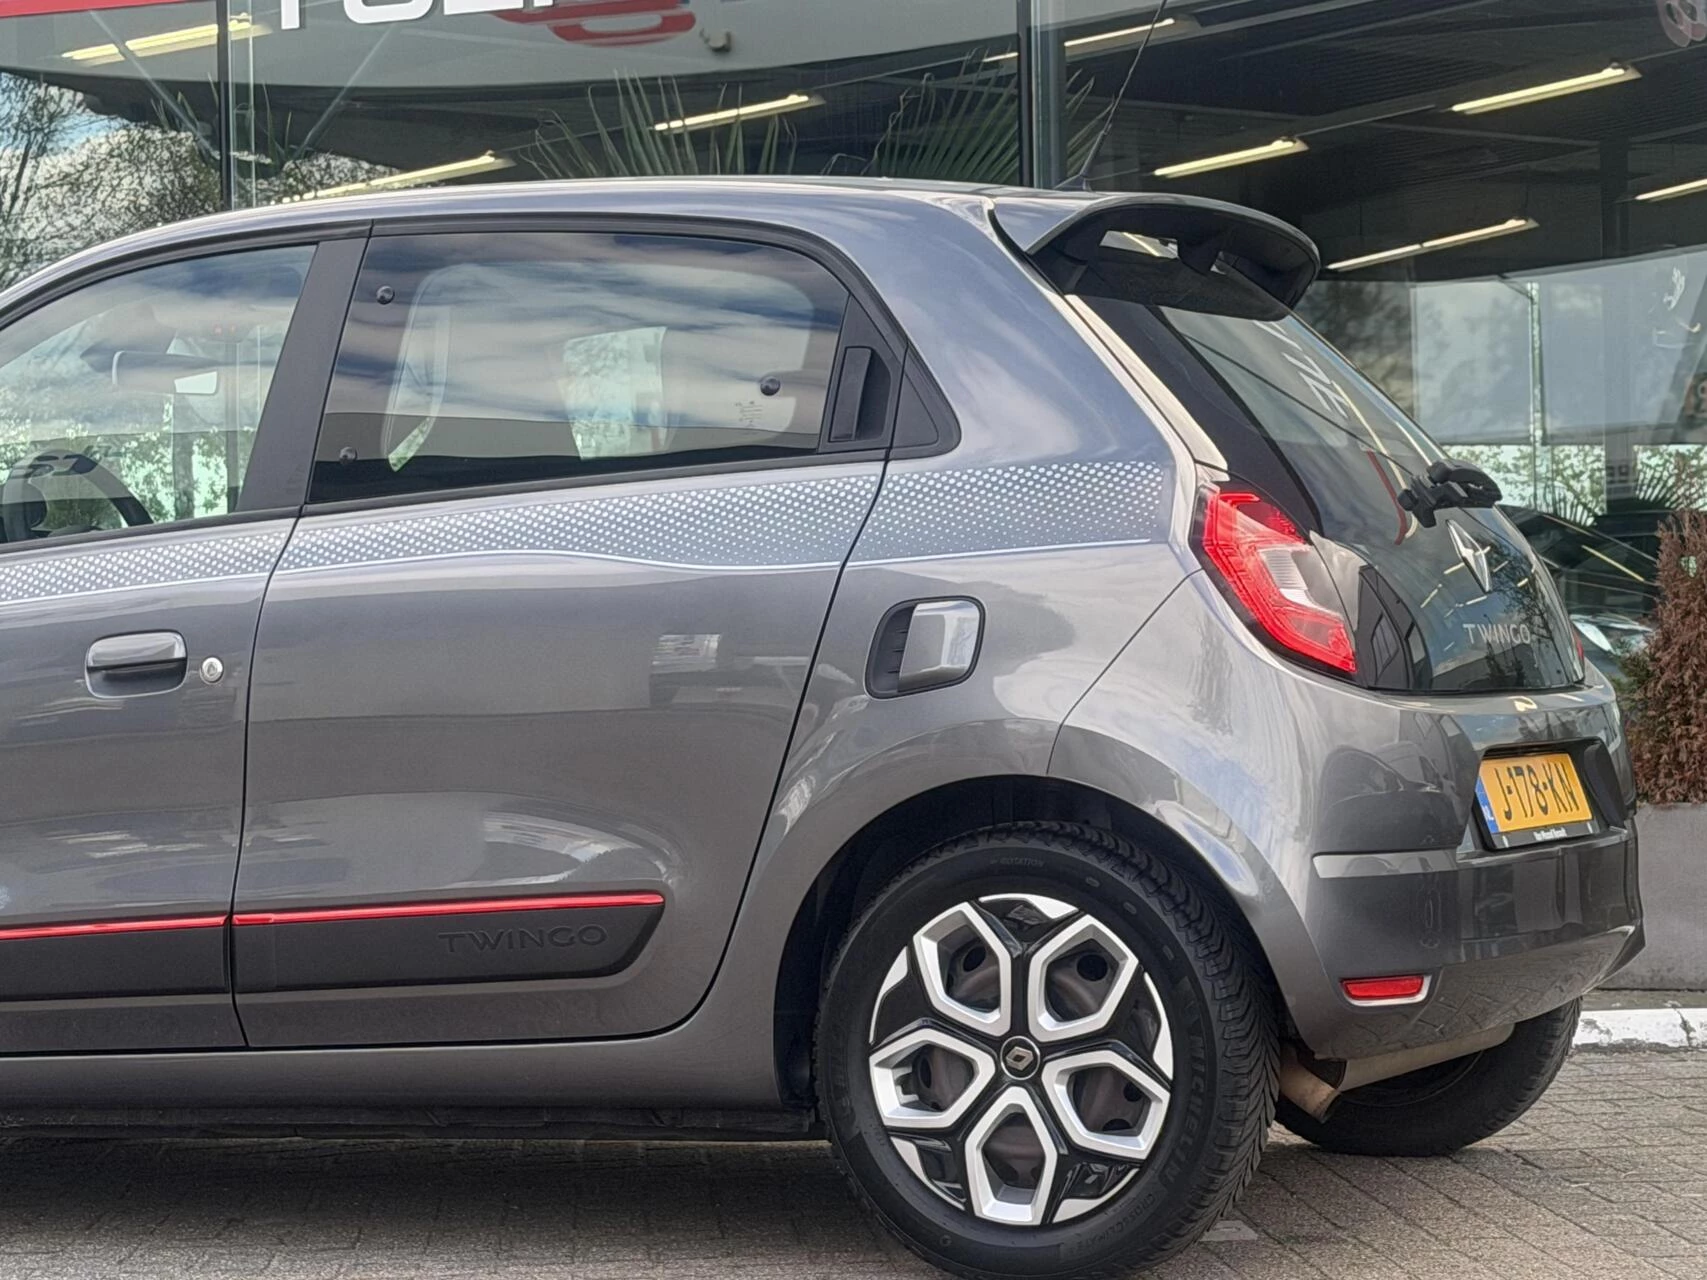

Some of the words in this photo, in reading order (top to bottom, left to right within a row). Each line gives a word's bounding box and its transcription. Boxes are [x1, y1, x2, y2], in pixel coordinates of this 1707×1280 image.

[1462, 623, 1531, 645] TWINGO
[1494, 762, 1580, 821] J-178-KN
[437, 923, 609, 953] TWINGO
[1159, 1034, 1207, 1184] MICHELIN
